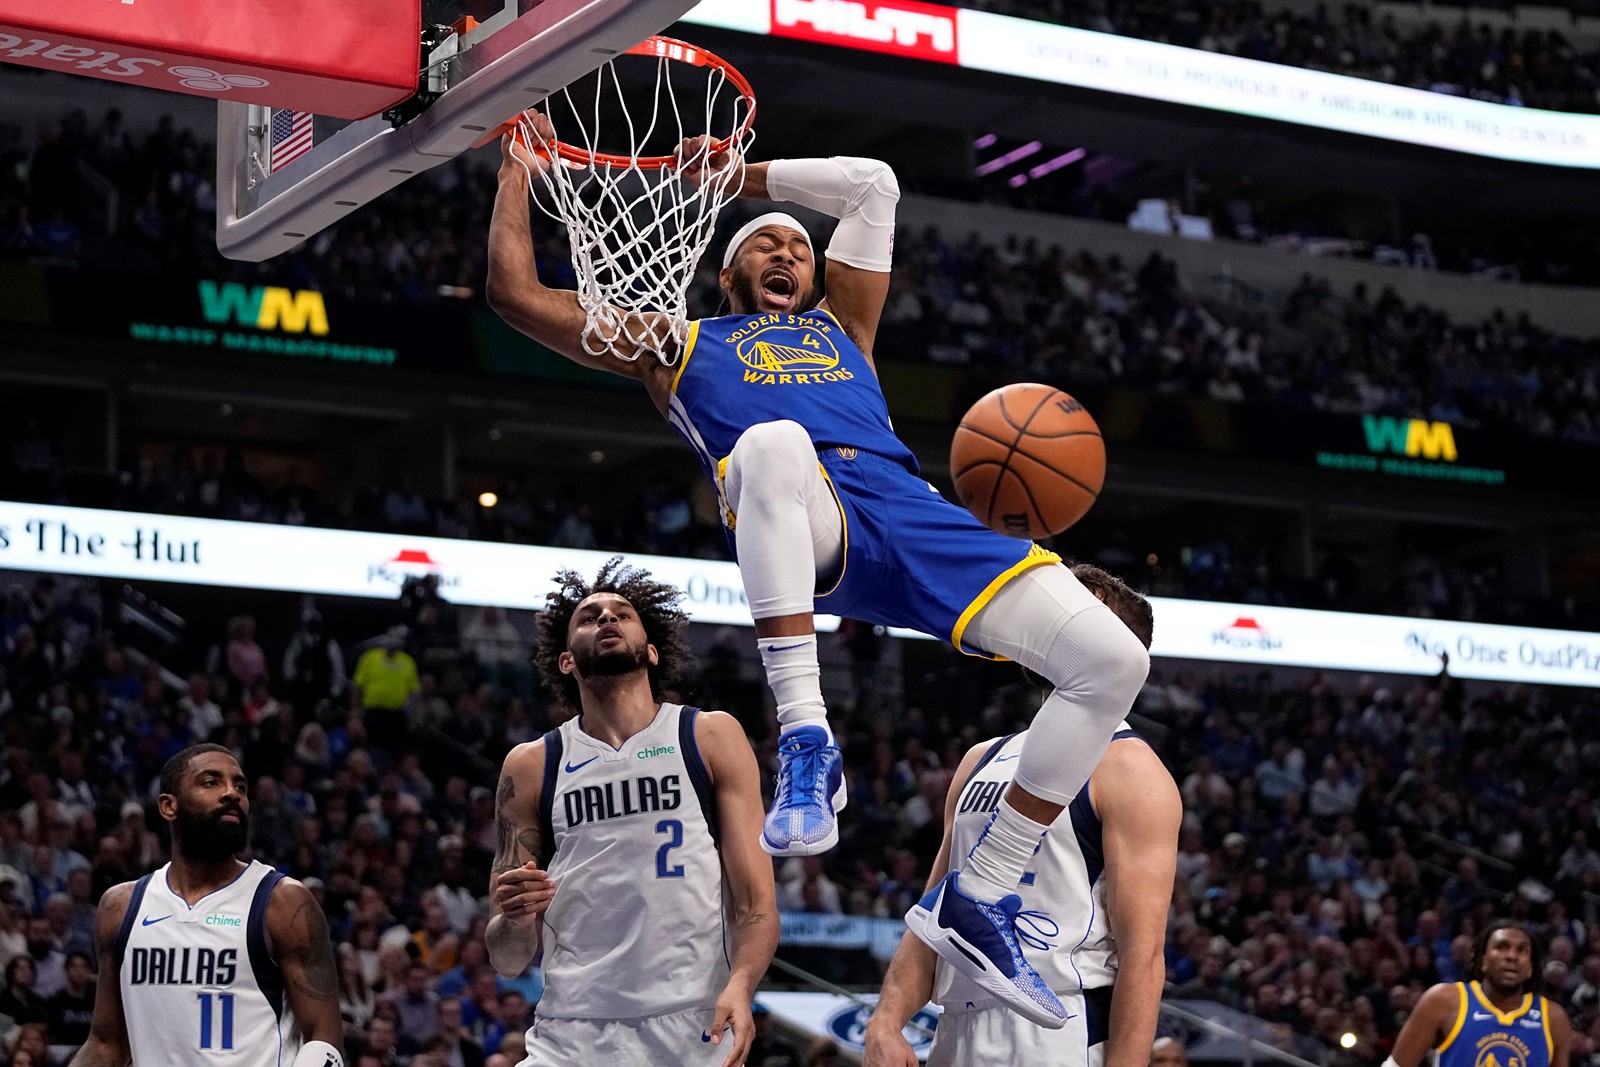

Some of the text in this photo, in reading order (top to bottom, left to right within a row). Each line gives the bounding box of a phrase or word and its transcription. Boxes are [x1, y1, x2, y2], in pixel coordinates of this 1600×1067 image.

[775, 0, 953, 51] HILTI
[198, 279, 329, 336] WM
[725, 313, 832, 344] GOLDEN STATE
[801, 333, 821, 350] 4
[742, 366, 855, 385] WARRIORS
[1361, 413, 1458, 463] WM
[26, 518, 105, 556] The
[121, 527, 201, 565] Hut
[637, 745, 675, 760] chime
[563, 774, 681, 829] DALLAS
[655, 819, 685, 879] 2
[205, 914, 241, 927] chime
[130, 947, 238, 986] DALLAS
[197, 992, 234, 1051] 11
